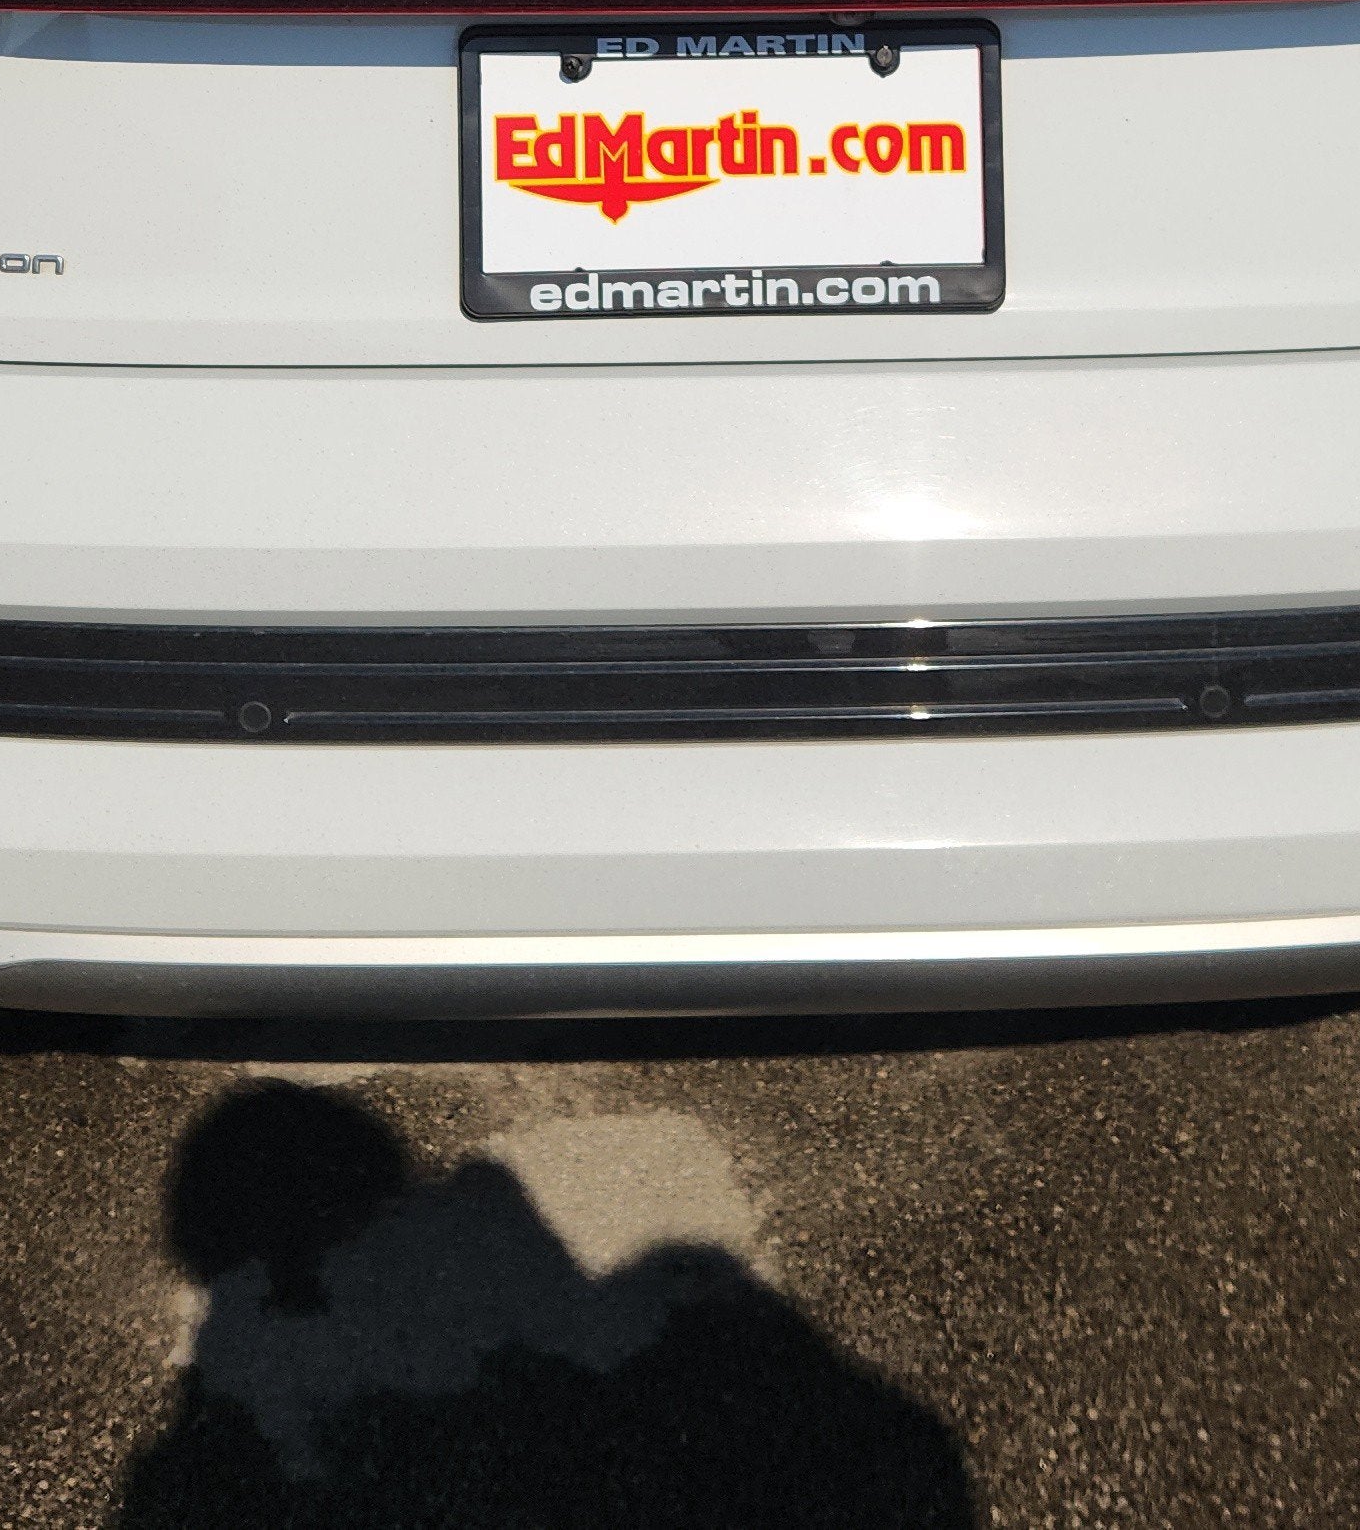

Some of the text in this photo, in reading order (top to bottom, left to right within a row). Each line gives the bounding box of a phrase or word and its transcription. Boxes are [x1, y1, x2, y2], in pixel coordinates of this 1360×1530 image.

[596, 33, 866, 58] ED MARTIN
[530, 270, 941, 311] edmartin.com
